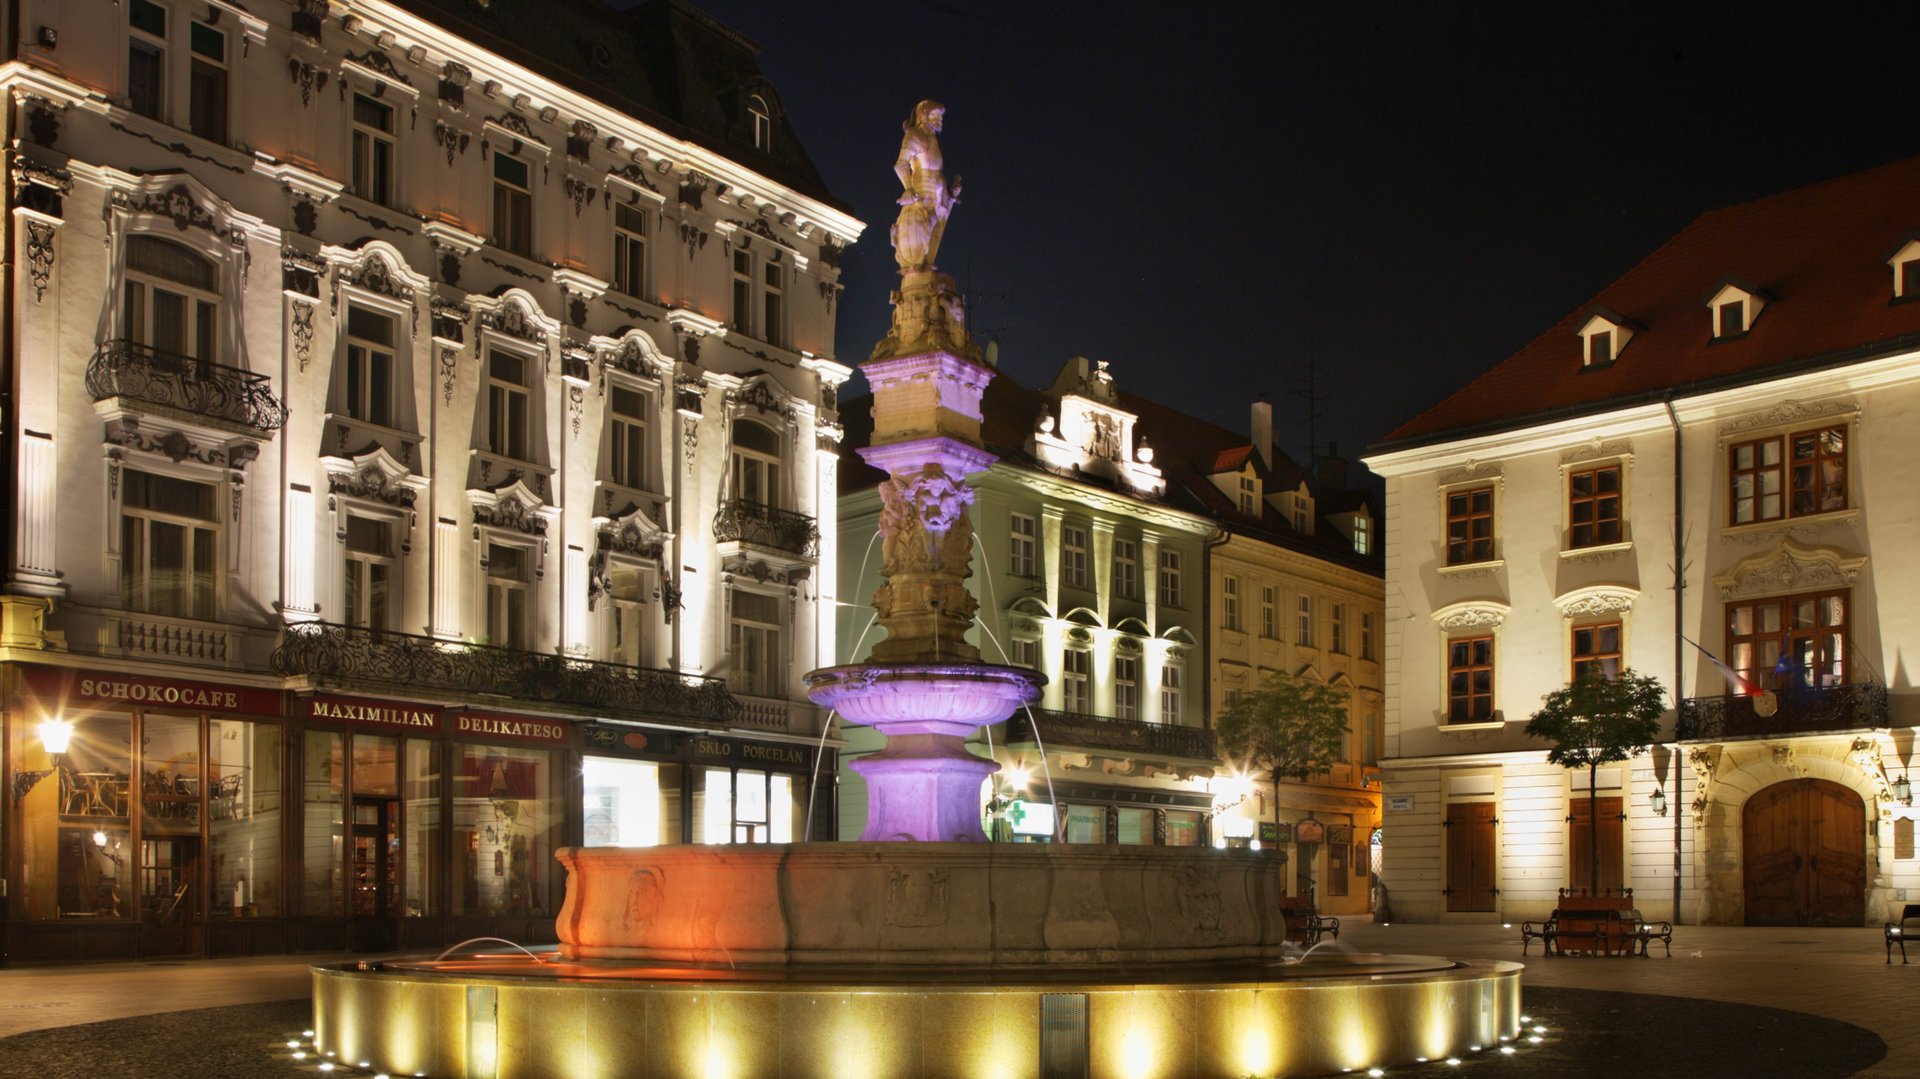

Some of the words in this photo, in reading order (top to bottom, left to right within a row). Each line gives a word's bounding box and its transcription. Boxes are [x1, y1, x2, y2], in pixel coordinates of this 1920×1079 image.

[80, 679, 238, 708] SCHOKOCAFE
[312, 701, 434, 727] MAXIMILIAN
[458, 717, 563, 739] DELIKATESO
[699, 740, 731, 756] SKLO
[743, 745, 803, 763] PORCELÁN
